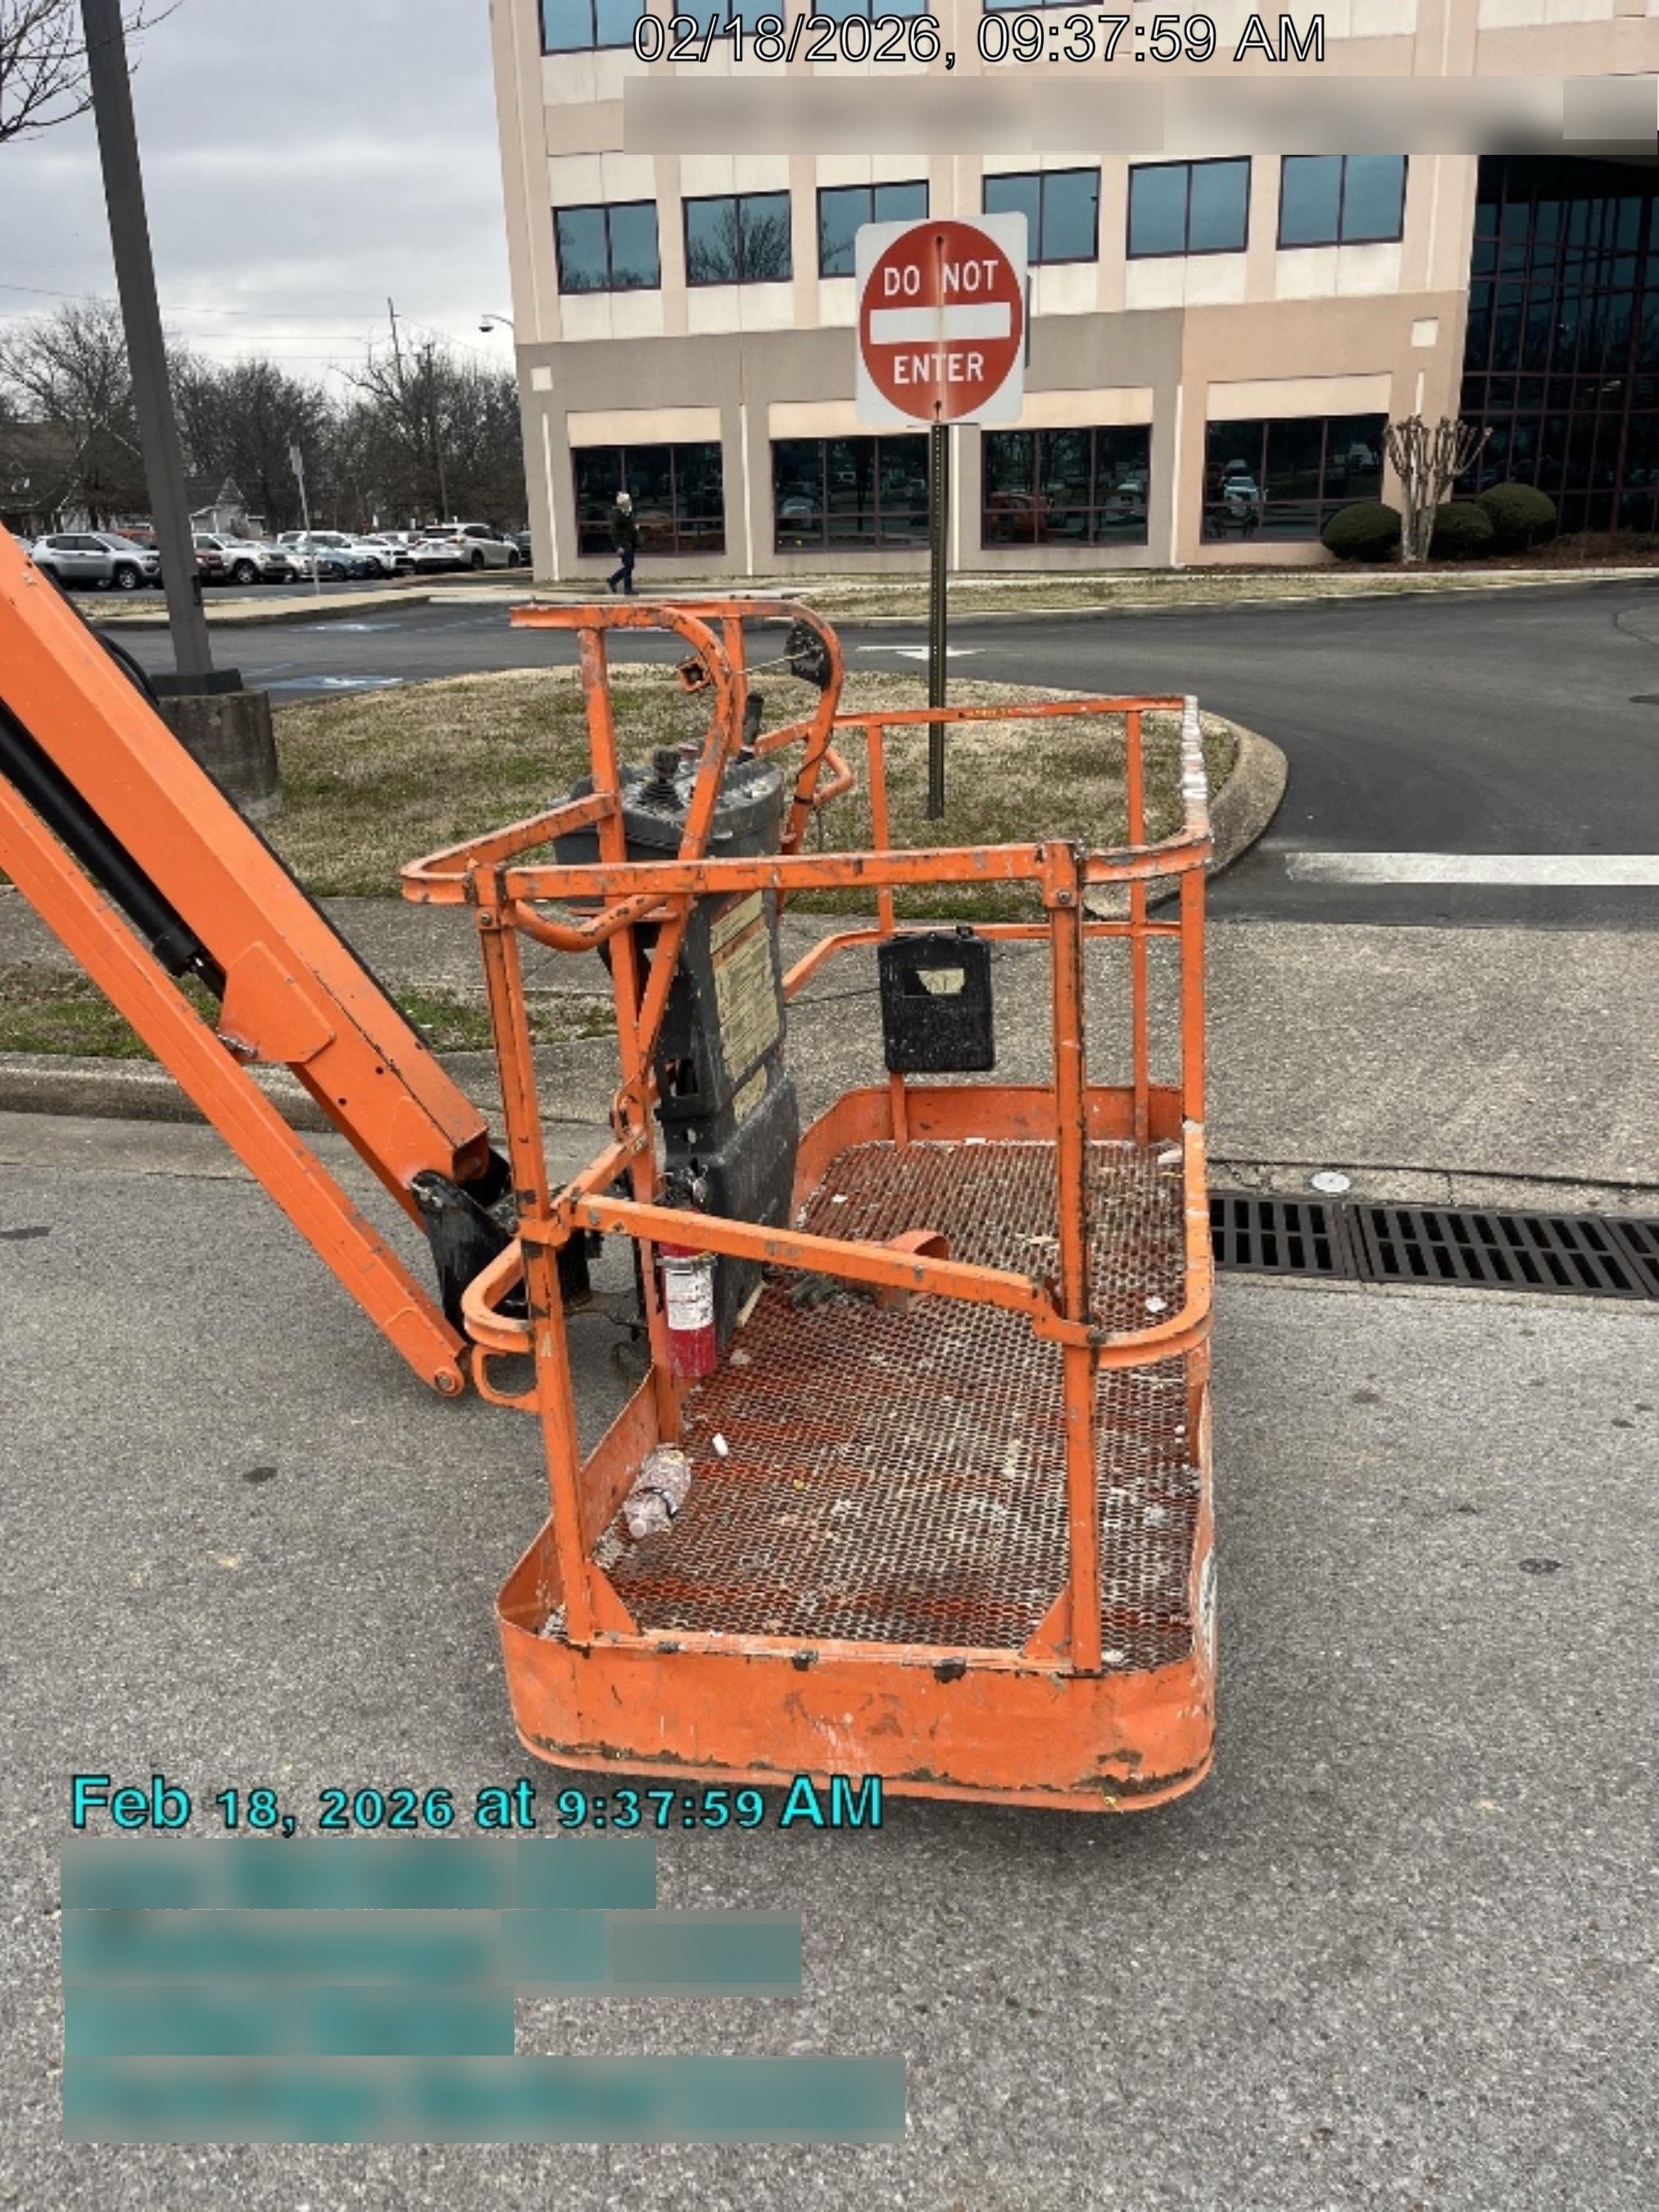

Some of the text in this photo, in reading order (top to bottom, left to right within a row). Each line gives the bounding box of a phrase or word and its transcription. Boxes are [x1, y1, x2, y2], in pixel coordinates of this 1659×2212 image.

[883, 260, 999, 296] DO NOT
[894, 351, 985, 384] ENTER
